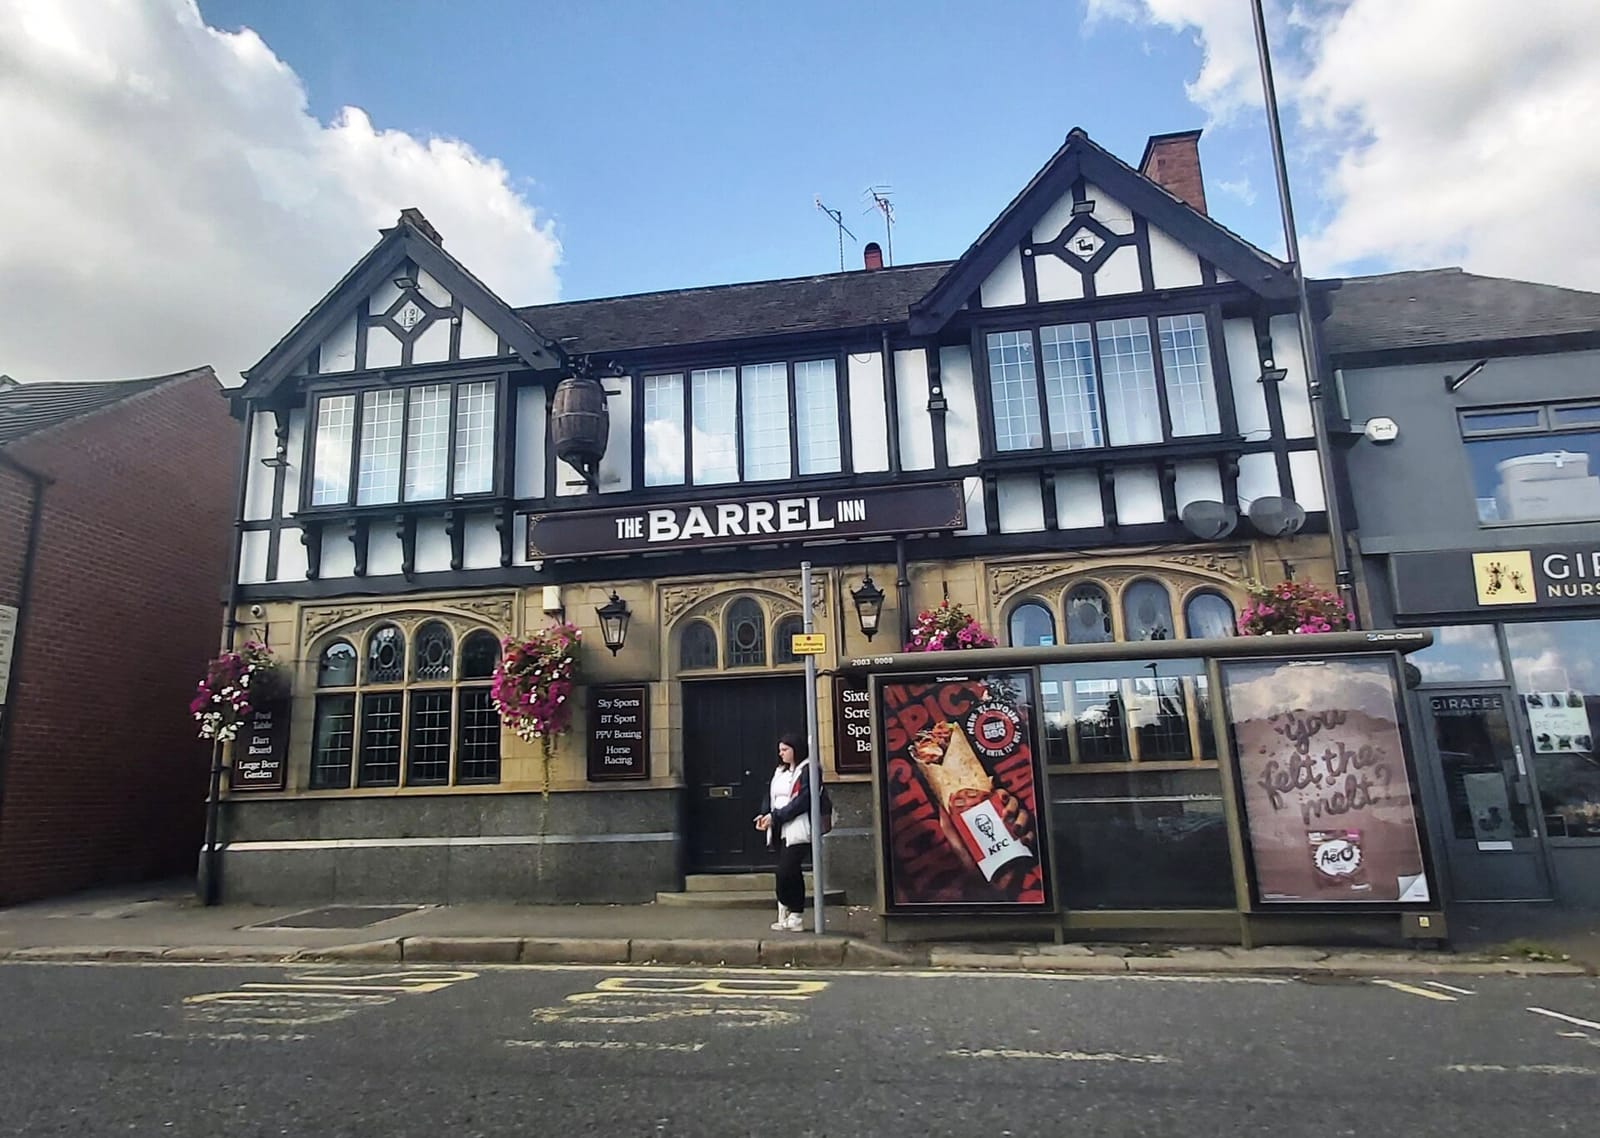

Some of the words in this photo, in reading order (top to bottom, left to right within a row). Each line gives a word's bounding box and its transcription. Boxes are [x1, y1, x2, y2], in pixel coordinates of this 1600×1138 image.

[615, 517, 644, 539] THE
[647, 496, 835, 542] BARREL
[837, 499, 866, 522] INN
[852, 658, 871, 667] 2003
[598, 699, 612, 709] Sky
[613, 698, 640, 709] Sports
[1431, 697, 1502, 710] GIRAFFE
[601, 714, 613, 724] BT
[613, 714, 637, 725] Sport
[966, 711, 978, 735] NEW
[595, 730, 612, 740] PPV
[847, 723, 871, 738] Spo
[856, 740, 873, 752] Ba
[604, 756, 633, 766] Racing
[1257, 752, 1323, 811] felt
[1321, 741, 1378, 777] the
[987, 838, 1010, 856] KFC
